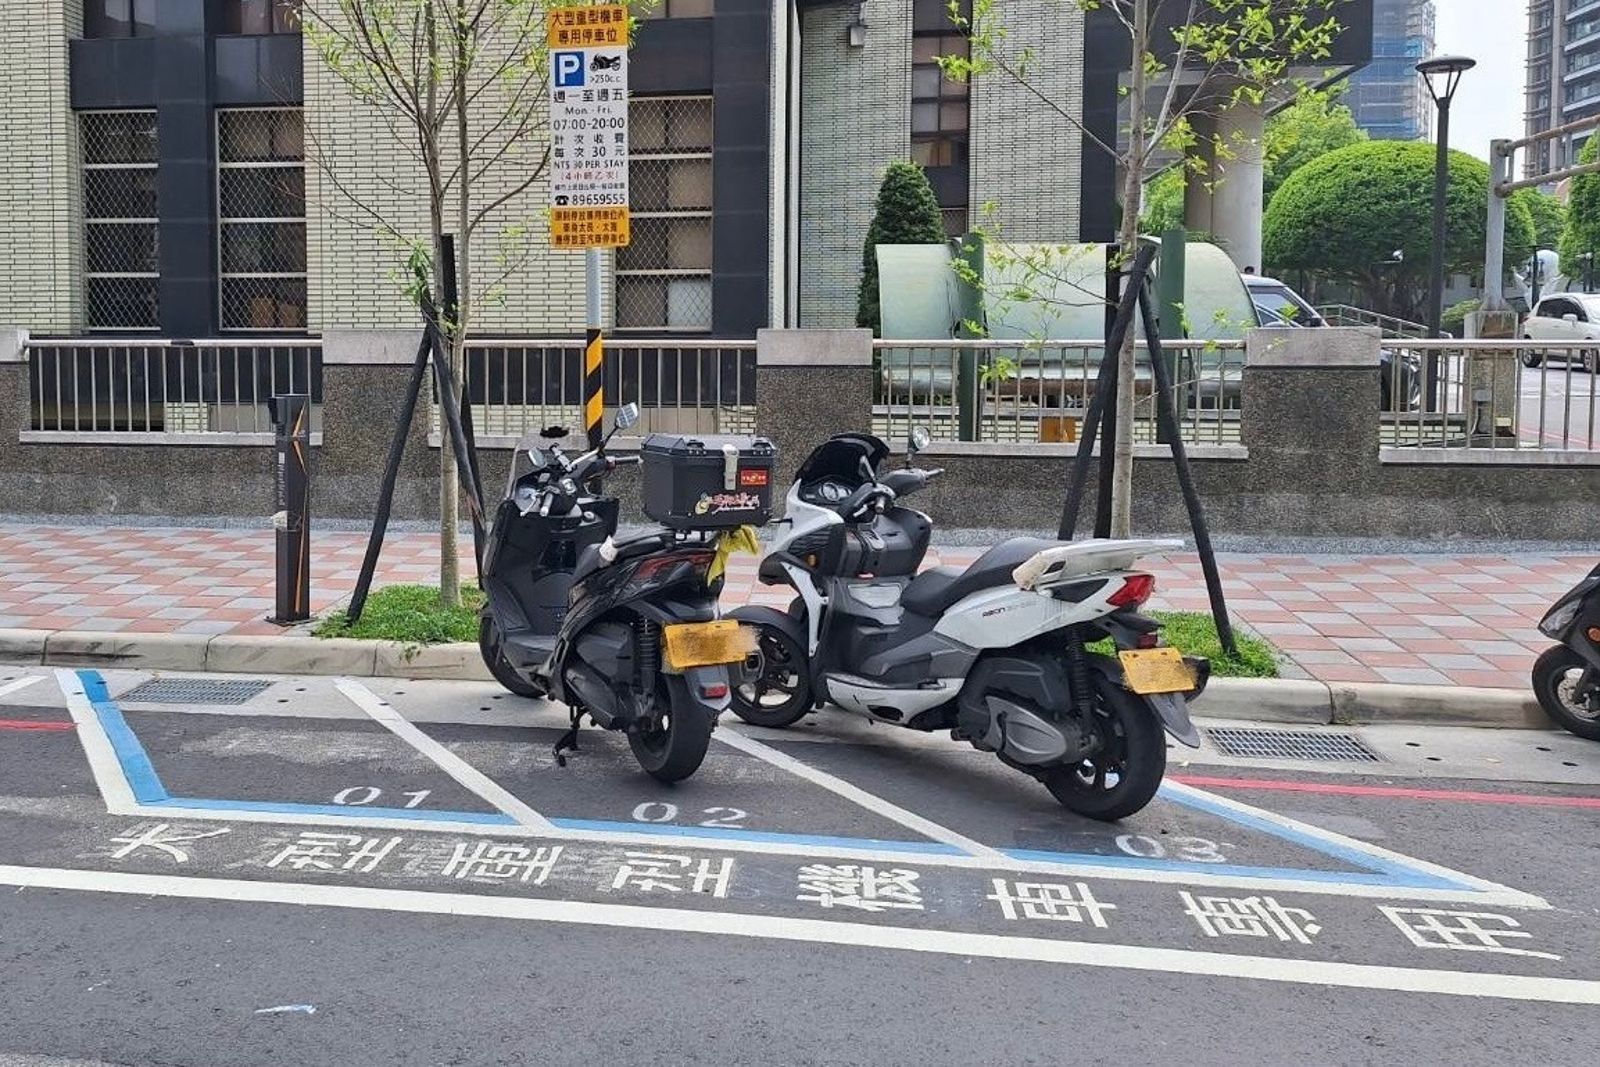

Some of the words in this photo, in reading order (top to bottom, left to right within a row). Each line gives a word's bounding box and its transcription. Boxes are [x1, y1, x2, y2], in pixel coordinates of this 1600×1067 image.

[552, 9, 623, 28] 大型重型機車
[558, 27, 617, 44] 專用停車位
[558, 54, 580, 85] P
[553, 88, 624, 104] 週一至週五
[553, 117, 625, 131] 07:00-20:00
[585, 160, 601, 169] PER
[604, 159, 624, 168] STAY
[572, 193, 625, 205] 89659555
[333, 786, 431, 808] 01
[632, 802, 747, 828] 02
[1115, 834, 1226, 863] 03
